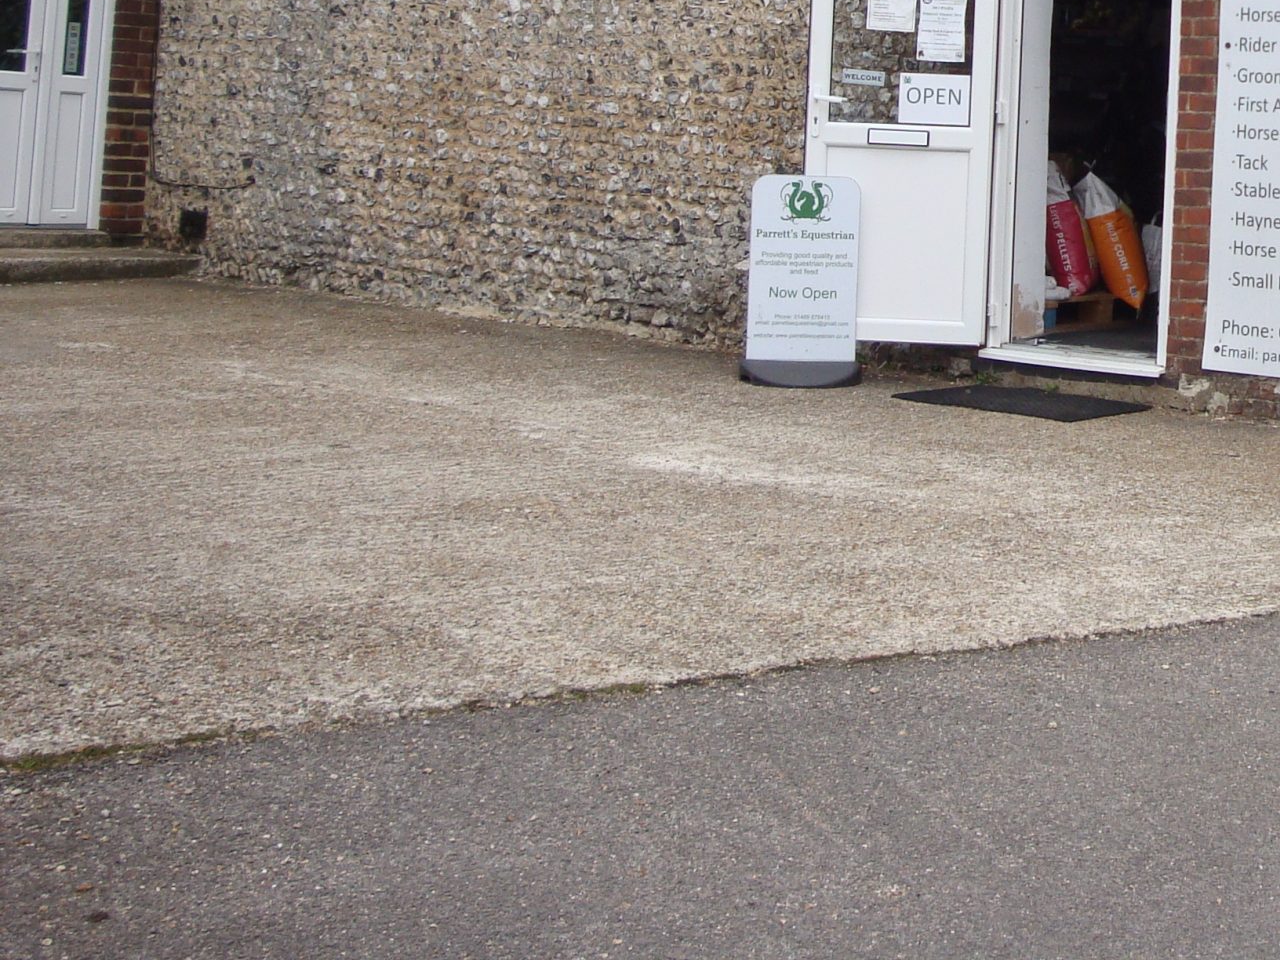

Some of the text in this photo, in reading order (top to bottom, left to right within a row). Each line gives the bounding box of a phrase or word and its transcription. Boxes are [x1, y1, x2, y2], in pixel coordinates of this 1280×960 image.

[1238, 37, 1276, 53] Rider
[844, 73, 882, 82] WELCOME
[906, 87, 962, 105] OPEN
[1237, 97, 1268, 113] First
[1236, 124, 1279, 141] Horse
[1236, 154, 1268, 171] Tack
[1234, 182, 1280, 200] Stable
[756, 229, 855, 241] Parrett's Equestrian
[761, 251, 792, 260] Providing
[794, 252, 810, 260] good
[812, 252, 833, 261] quality
[1056, 232, 1072, 272] PELLETS
[1232, 241, 1277, 258] Horse
[789, 260, 824, 268] equestrian
[1232, 272, 1273, 290] Small
[768, 286, 837, 301] Now Open
[1221, 319, 1274, 339] Phone:
[1220, 345, 1258, 361] Email:
